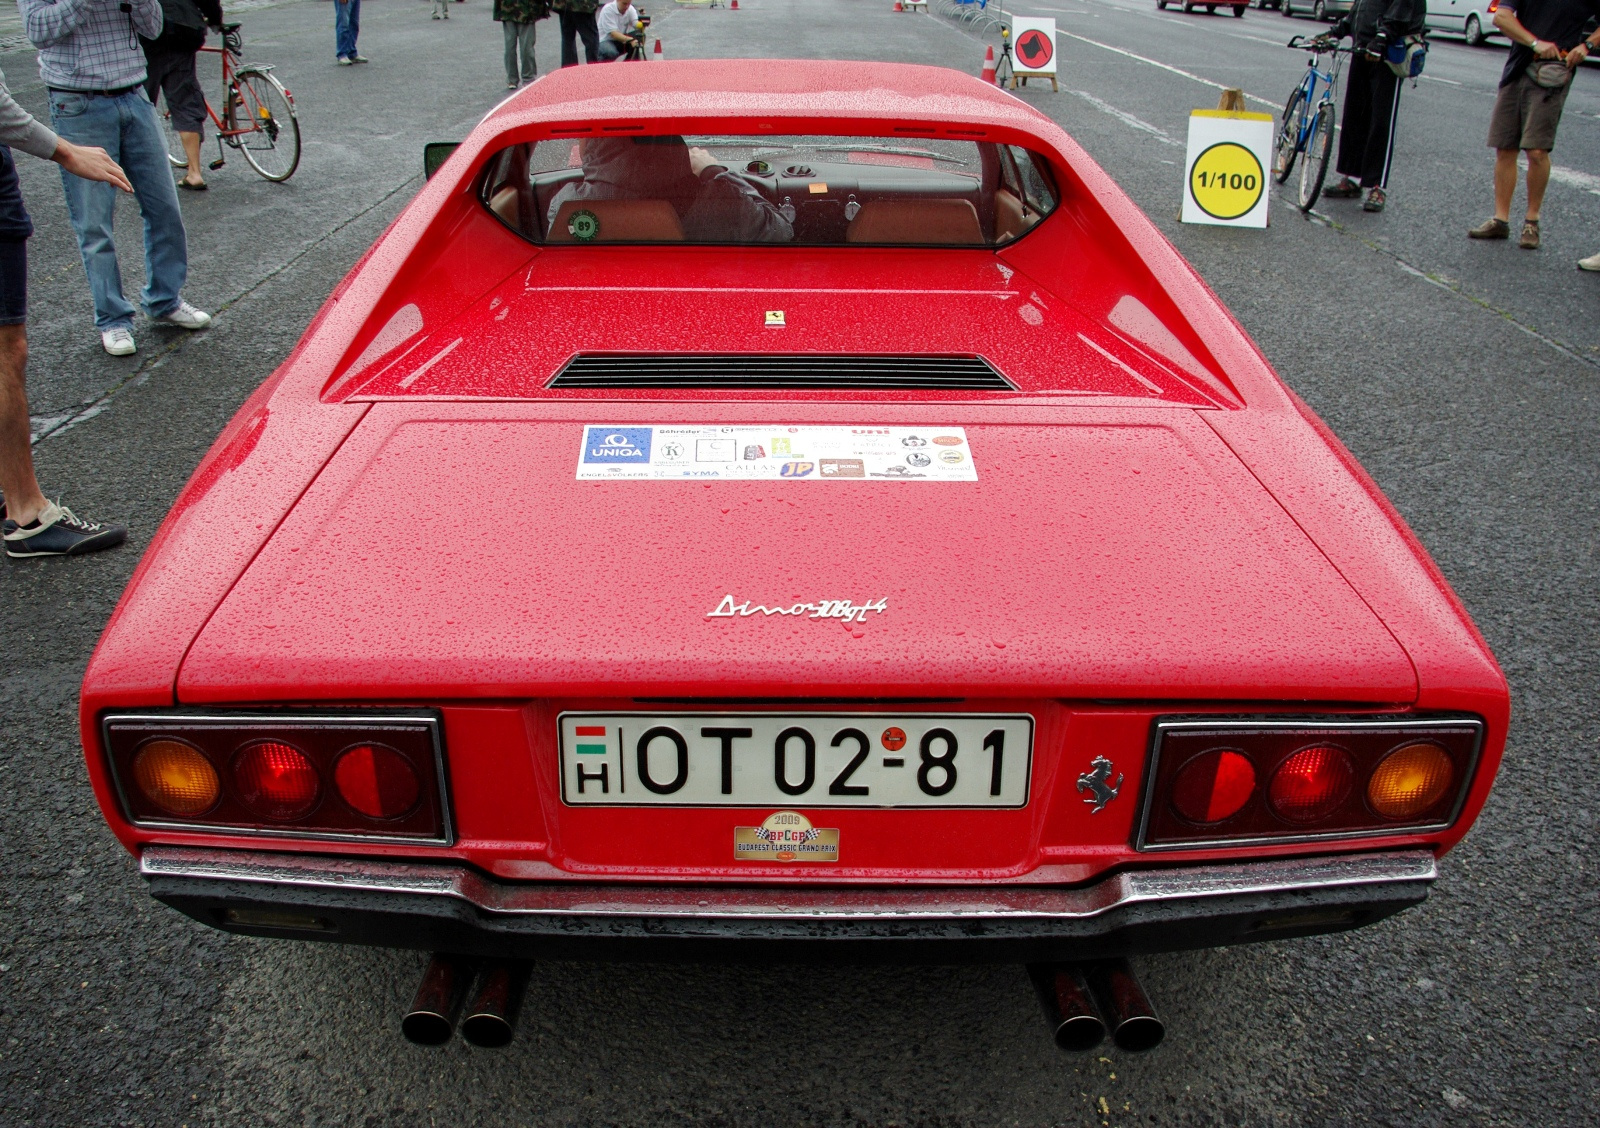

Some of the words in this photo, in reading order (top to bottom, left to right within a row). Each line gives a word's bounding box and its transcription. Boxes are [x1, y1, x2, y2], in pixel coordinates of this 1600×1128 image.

[1198, 171, 1256, 191] 1/100
[578, 221, 590, 231] 89
[592, 448, 642, 457] UNIQA
[577, 763, 608, 793] H
[774, 814, 801, 825] 2009
[770, 830, 806, 841] BPCGP
[738, 843, 770, 851] BUDAPEST
[771, 844, 797, 852] CLASSIC
